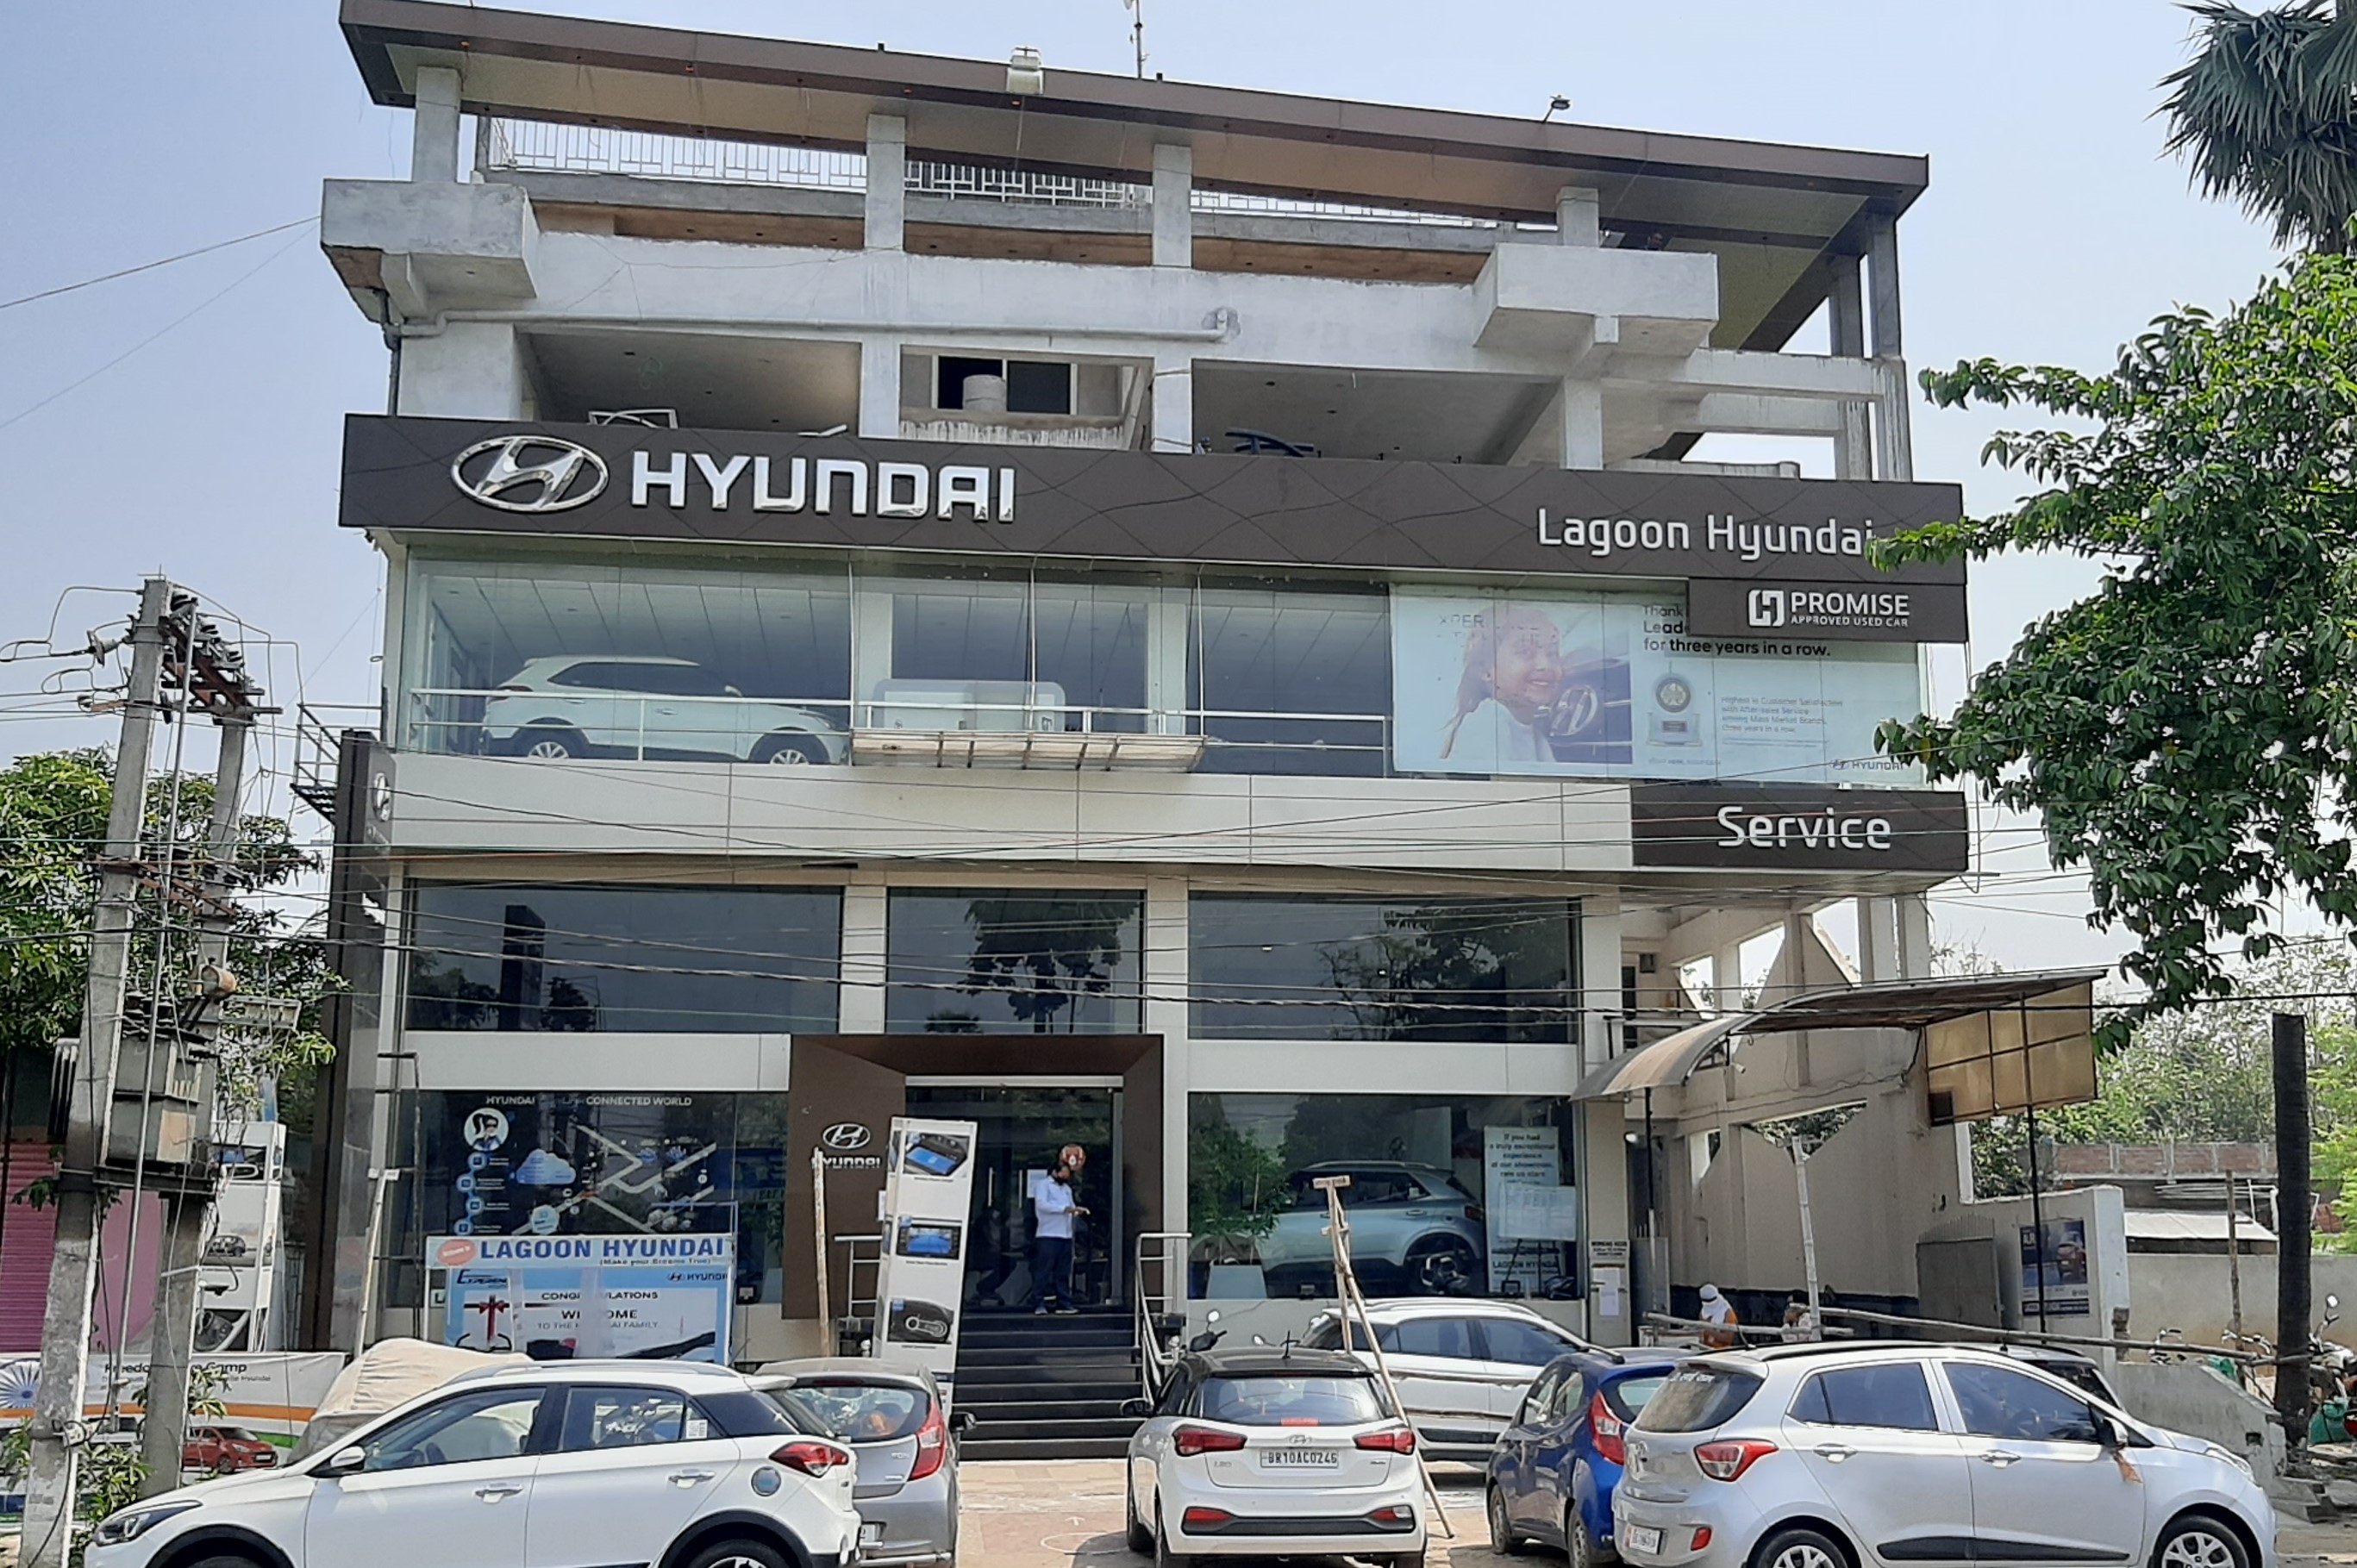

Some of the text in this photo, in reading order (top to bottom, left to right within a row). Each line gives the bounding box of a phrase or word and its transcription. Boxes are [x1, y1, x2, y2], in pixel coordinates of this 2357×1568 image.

[631, 450, 1016, 522] HYUNDAI
[1537, 508, 1873, 562] Lagoon Hyundai
[1643, 605, 1684, 617] Thank
[1791, 591, 1910, 616] PROMISE
[1791, 615, 1909, 628] APPROVED USED CAR
[1644, 637, 1831, 657] for three years in a row.
[1716, 805, 1891, 850] Service
[485, 1096, 535, 1105] HYUNDAI
[586, 1096, 651, 1106] CONNECTED
[652, 1096, 692, 1106] WORLD
[480, 1239, 591, 1259] LAGOON
[603, 1238, 724, 1258] HYUNDAI
